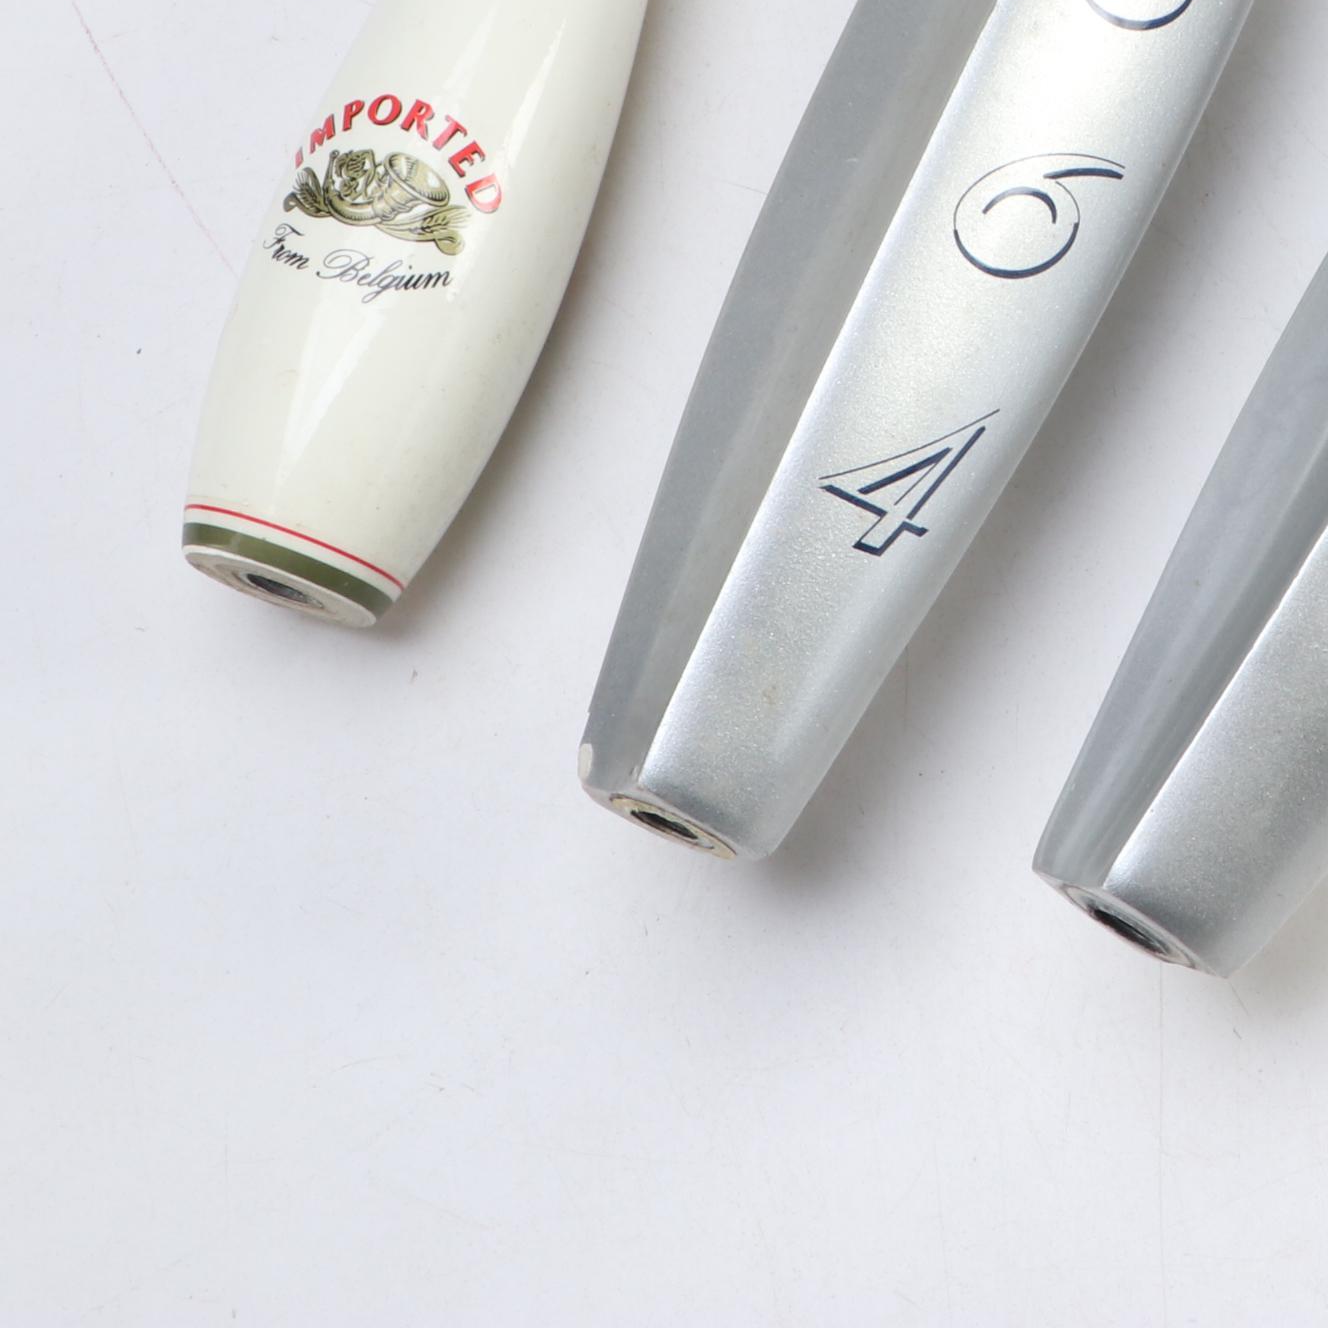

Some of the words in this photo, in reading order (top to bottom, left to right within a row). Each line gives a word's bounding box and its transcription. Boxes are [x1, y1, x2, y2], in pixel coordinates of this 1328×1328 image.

[295, 94, 502, 214] IMPORTED
[263, 223, 309, 270] From
[316, 249, 451, 303] Belgium
